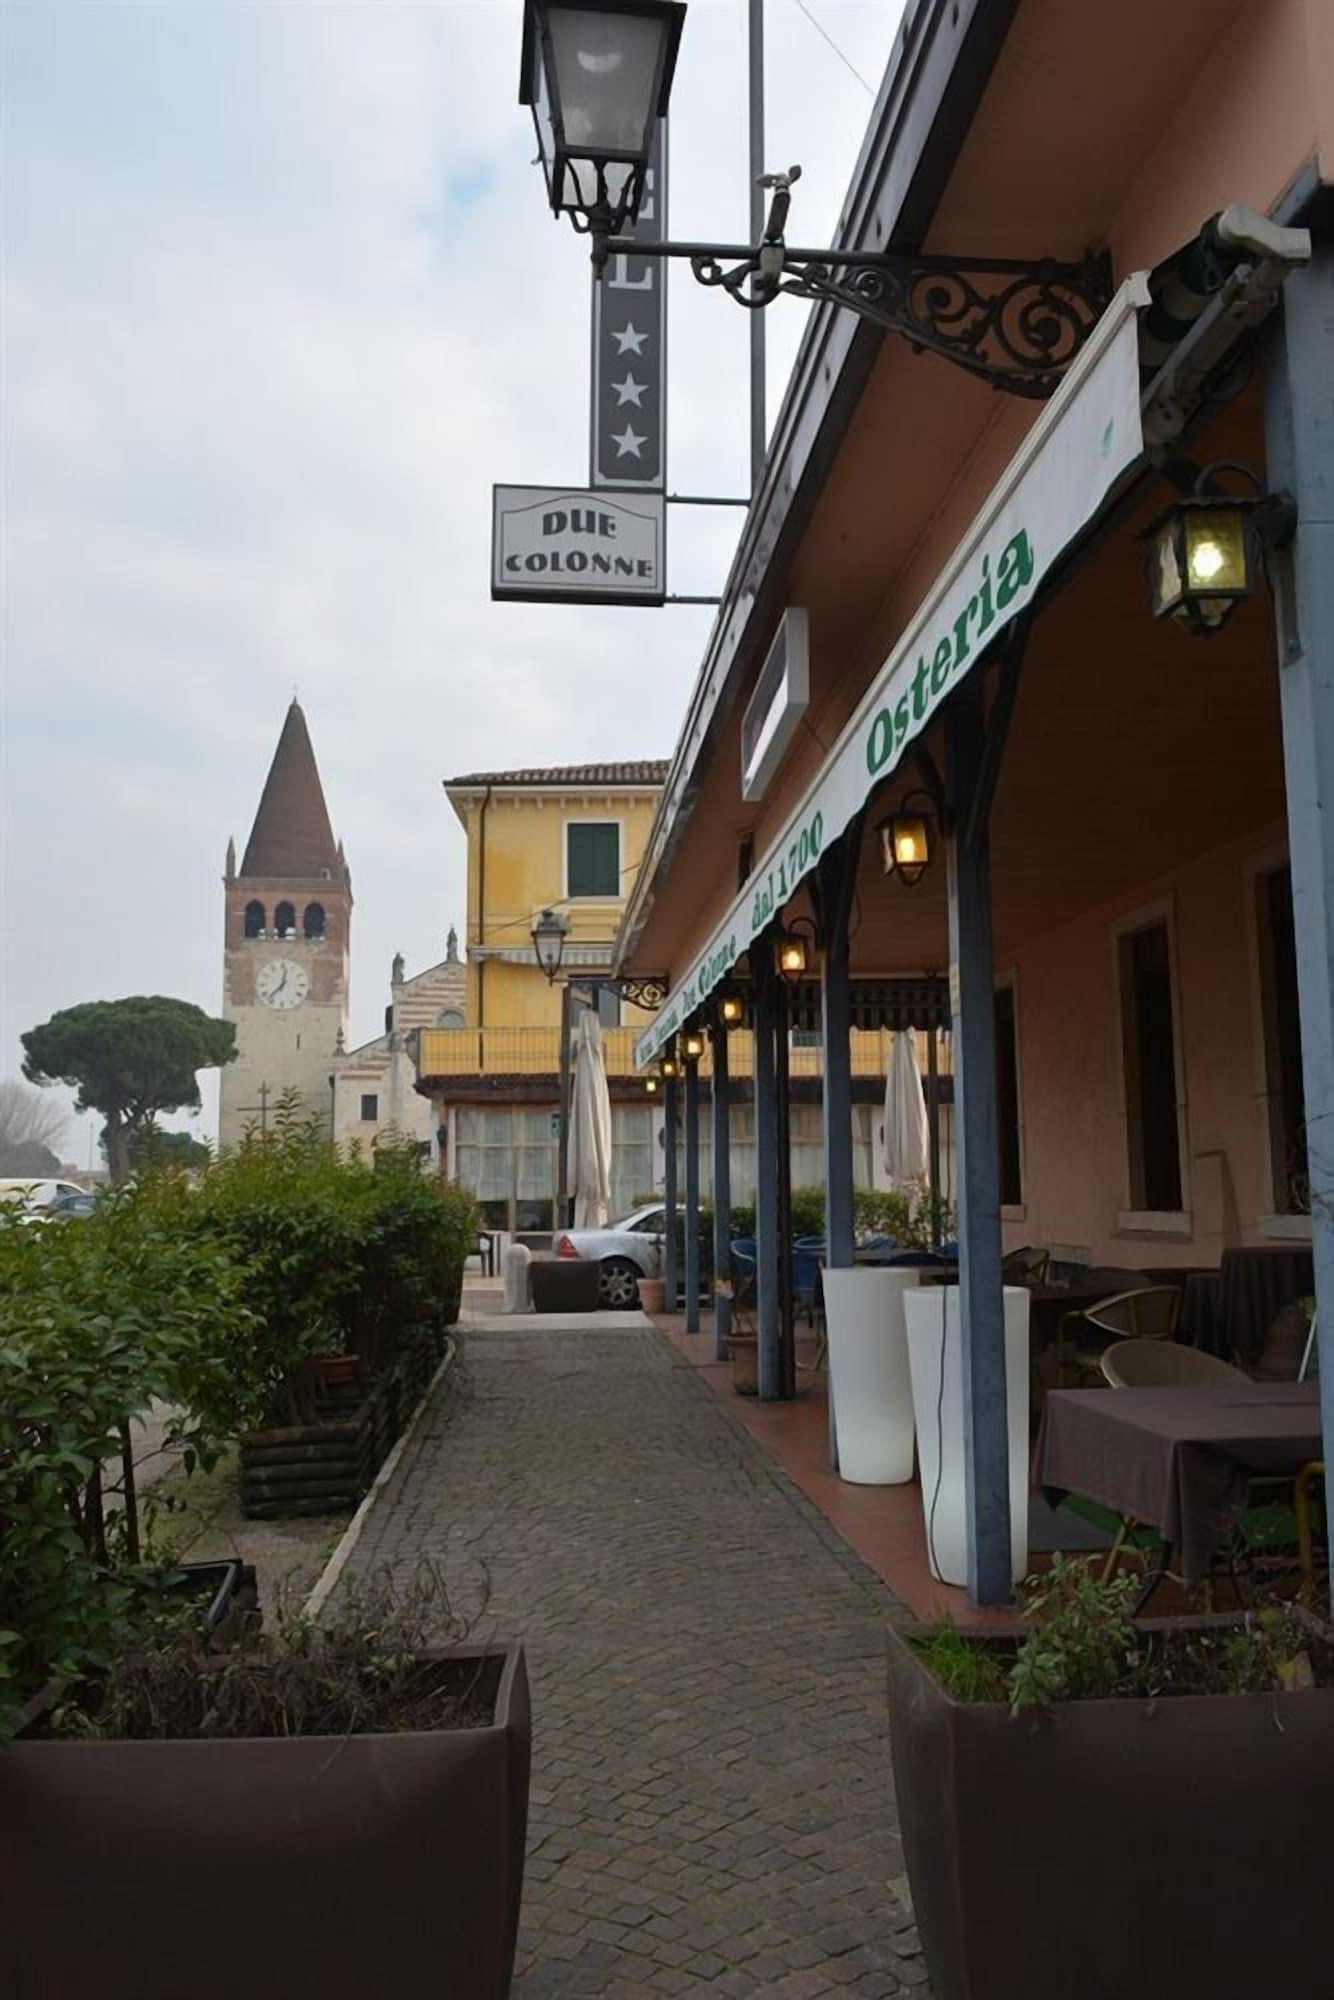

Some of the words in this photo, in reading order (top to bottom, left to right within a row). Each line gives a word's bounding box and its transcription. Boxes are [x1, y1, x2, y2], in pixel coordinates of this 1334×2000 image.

[542, 509, 617, 539] DUE
[505, 551, 653, 579] COLONNE
[866, 527, 1035, 776] Osteria
[752, 873, 775, 931] dal
[778, 810, 824, 899] 1700
